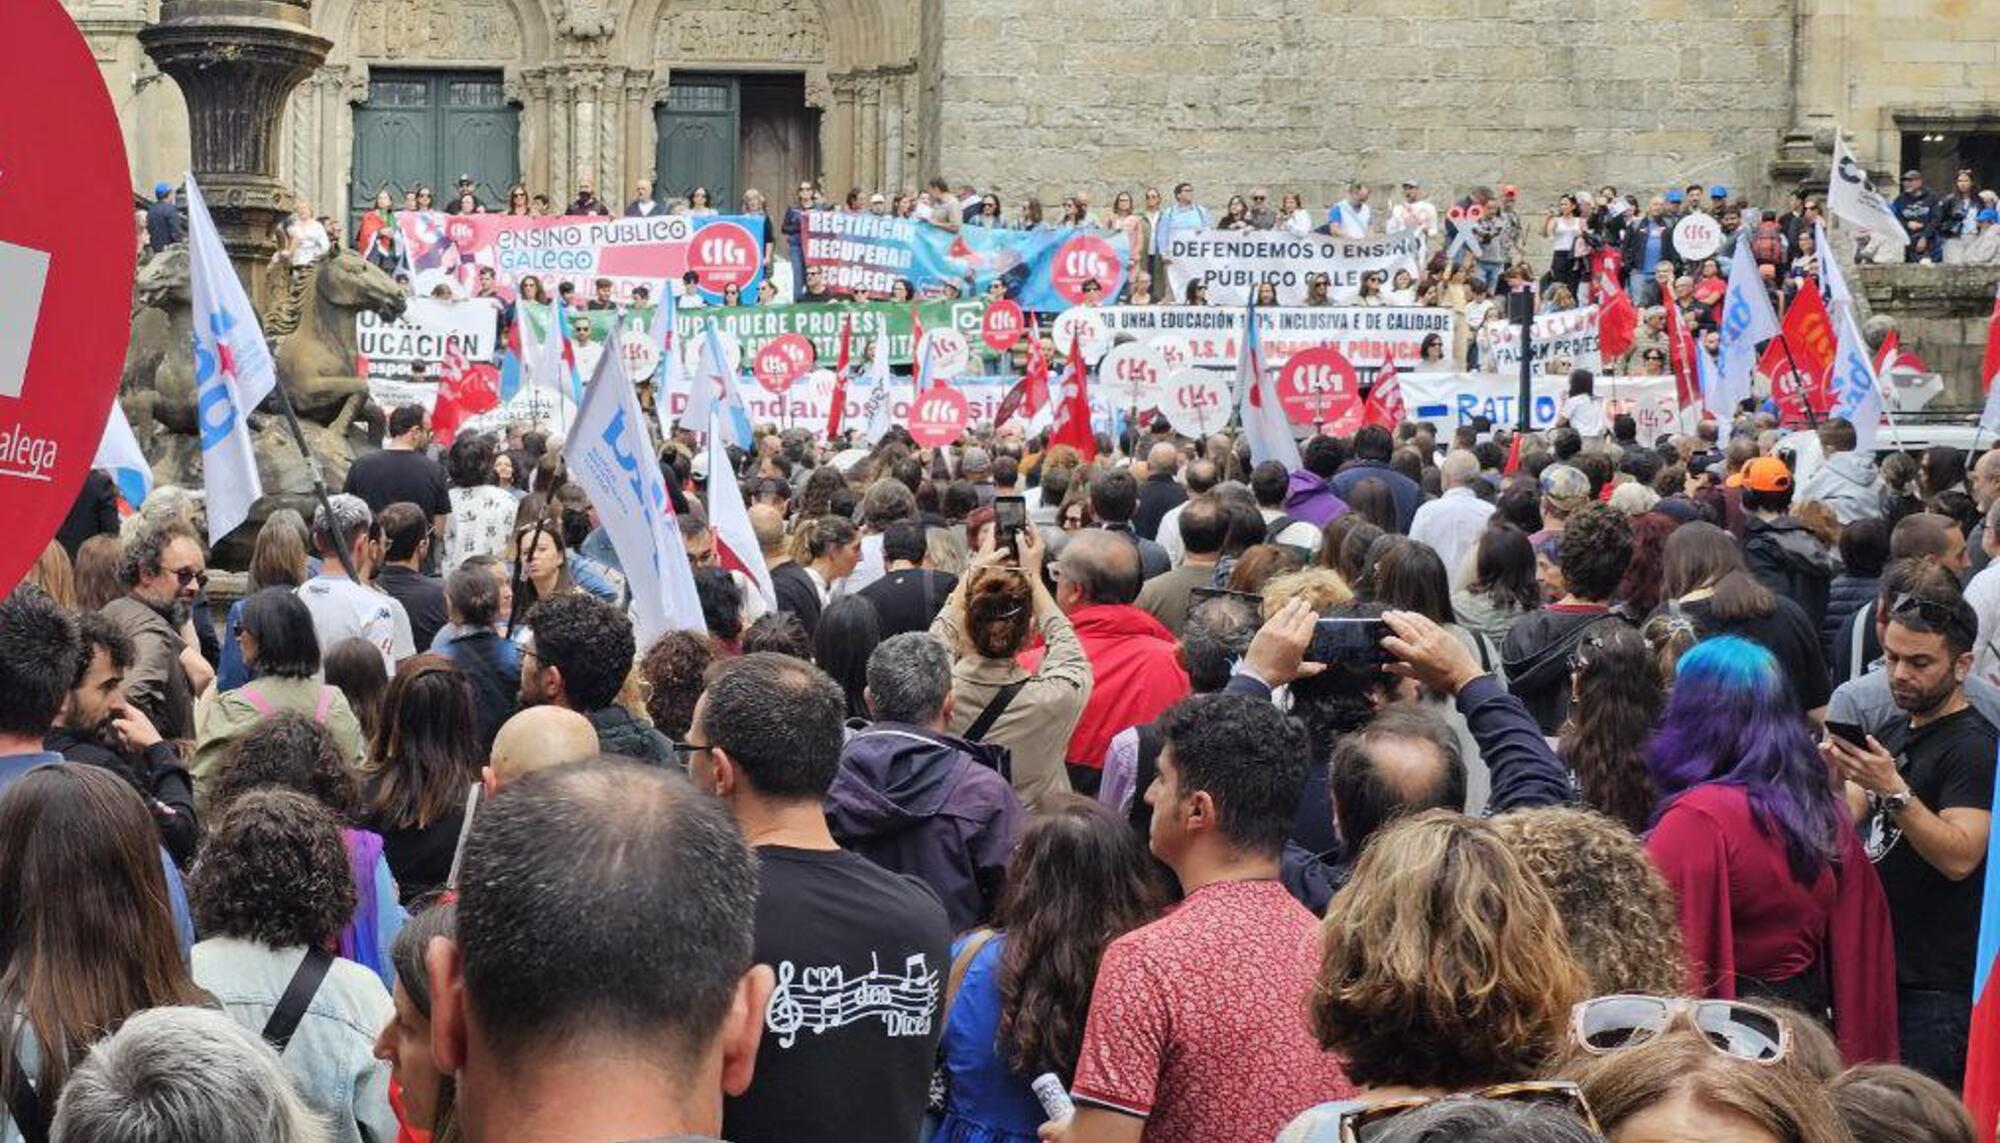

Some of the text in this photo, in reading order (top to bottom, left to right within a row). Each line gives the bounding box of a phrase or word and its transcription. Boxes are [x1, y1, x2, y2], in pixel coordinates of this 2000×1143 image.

[808, 211, 915, 244] RECTIFICAR
[701, 238, 746, 266] CIG
[1173, 240, 1314, 259] DEFENDEMOS
[1321, 241, 1335, 259] O
[1066, 250, 1108, 279] CIG
[990, 310, 1017, 330] CIG
[1122, 312, 1156, 328] UNHA
[1161, 310, 1234, 329] EDUCACIÓN
[1279, 312, 1348, 329] INCLUSIVA
[1353, 313, 1360, 329] E
[1366, 313, 1382, 330] DE
[1387, 313, 1450, 332] CALIDADE
[1292, 363, 1344, 394] CIG
[922, 400, 960, 423] CIG
[855, 980, 892, 1006] dos
[882, 1010, 931, 1037] Dices
